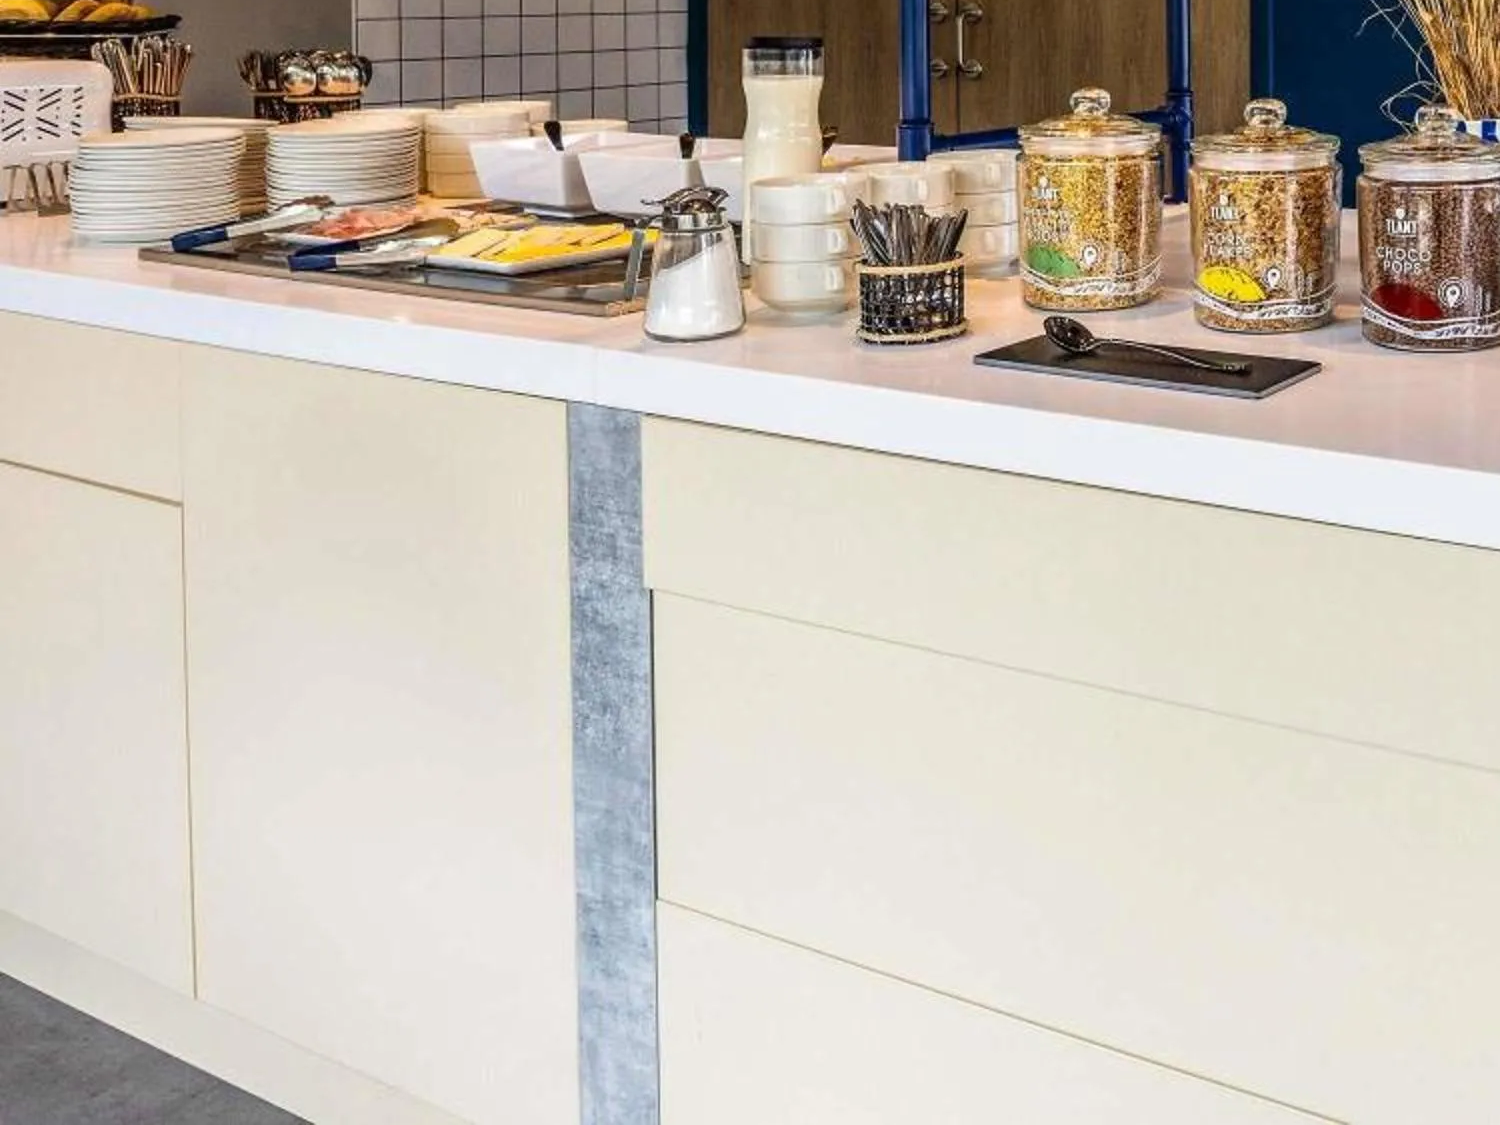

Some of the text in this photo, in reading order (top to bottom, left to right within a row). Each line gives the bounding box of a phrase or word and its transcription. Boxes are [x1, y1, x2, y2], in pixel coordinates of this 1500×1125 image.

[1385, 218, 1417, 235] TLANT
[1376, 246, 1432, 262] CHOCO
[1383, 260, 1422, 276] POPS
